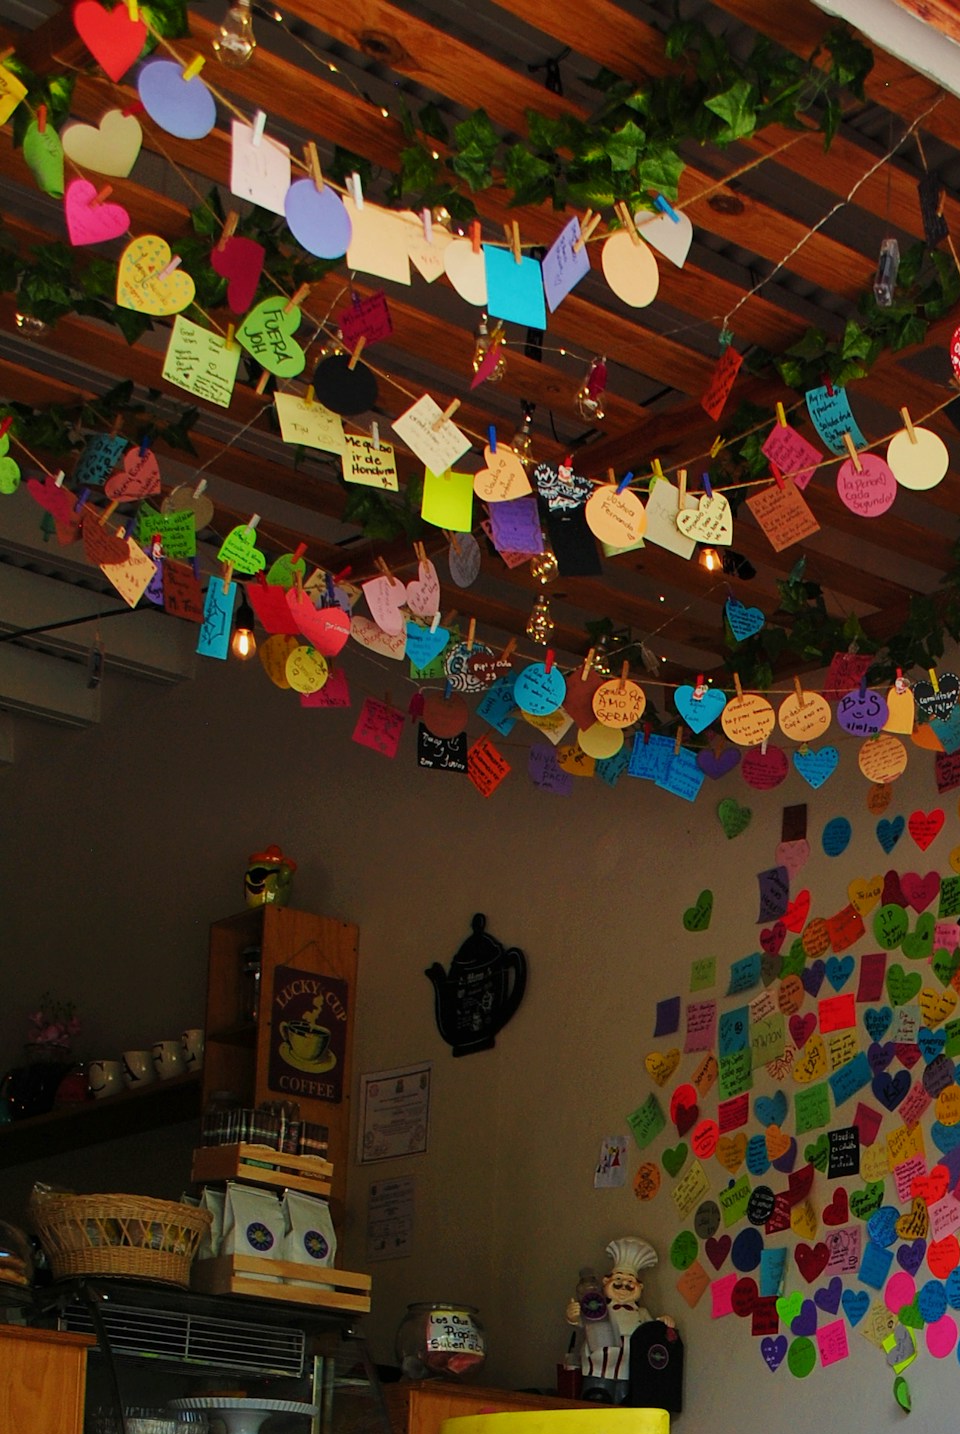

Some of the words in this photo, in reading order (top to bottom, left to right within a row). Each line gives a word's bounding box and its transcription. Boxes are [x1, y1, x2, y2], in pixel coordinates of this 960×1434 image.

[263, 309, 293, 364] FUERA
[276, 979, 322, 1010] LUCKY
[324, 991, 348, 1023] CUP
[279, 1074, 336, 1099] COFFEE
